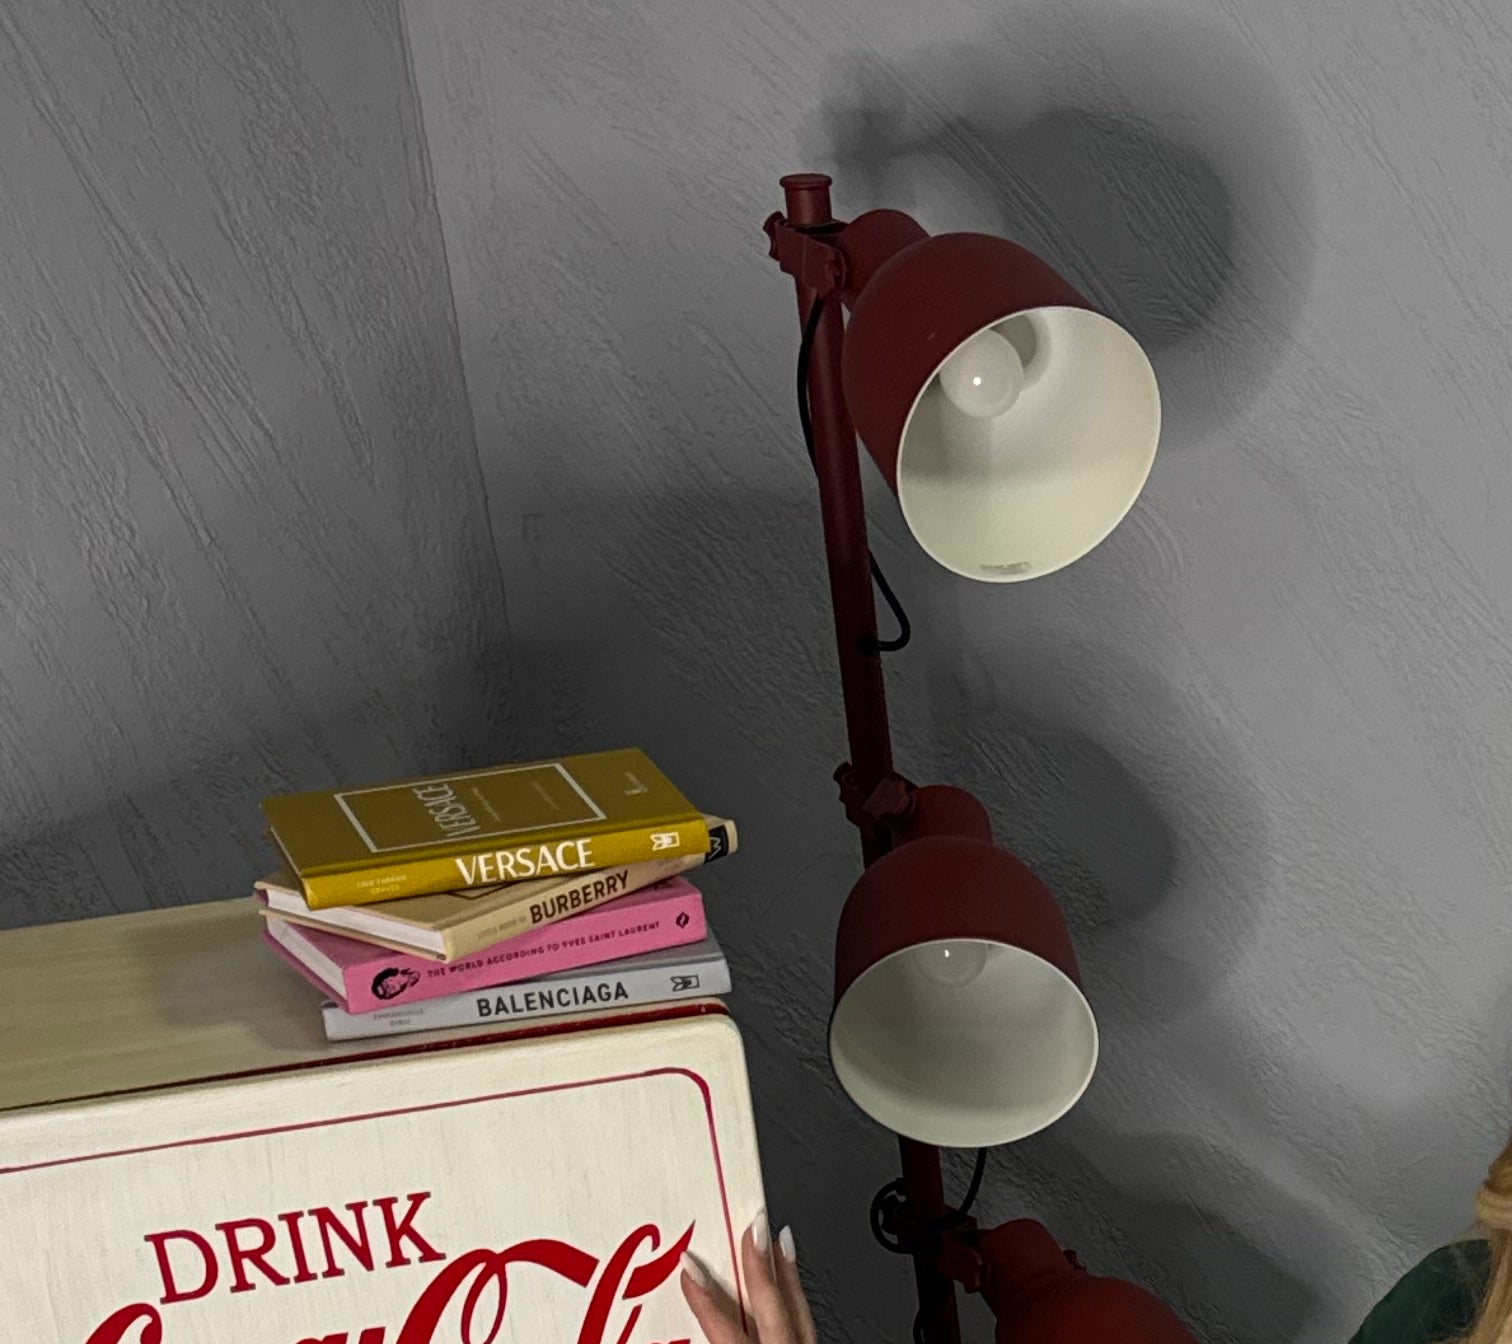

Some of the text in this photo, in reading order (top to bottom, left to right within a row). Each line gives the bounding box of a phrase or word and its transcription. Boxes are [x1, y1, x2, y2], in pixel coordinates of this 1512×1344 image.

[411, 783, 481, 837] VERSACE
[454, 838, 596, 885] VERSACE
[529, 869, 629, 925] BURBERRY
[426, 920, 661, 978] THE WORLD ACCORDING TO YVES SAINT LAURENT
[476, 981, 629, 1018] BALENCIAGA
[144, 1190, 447, 1305] DRINK
